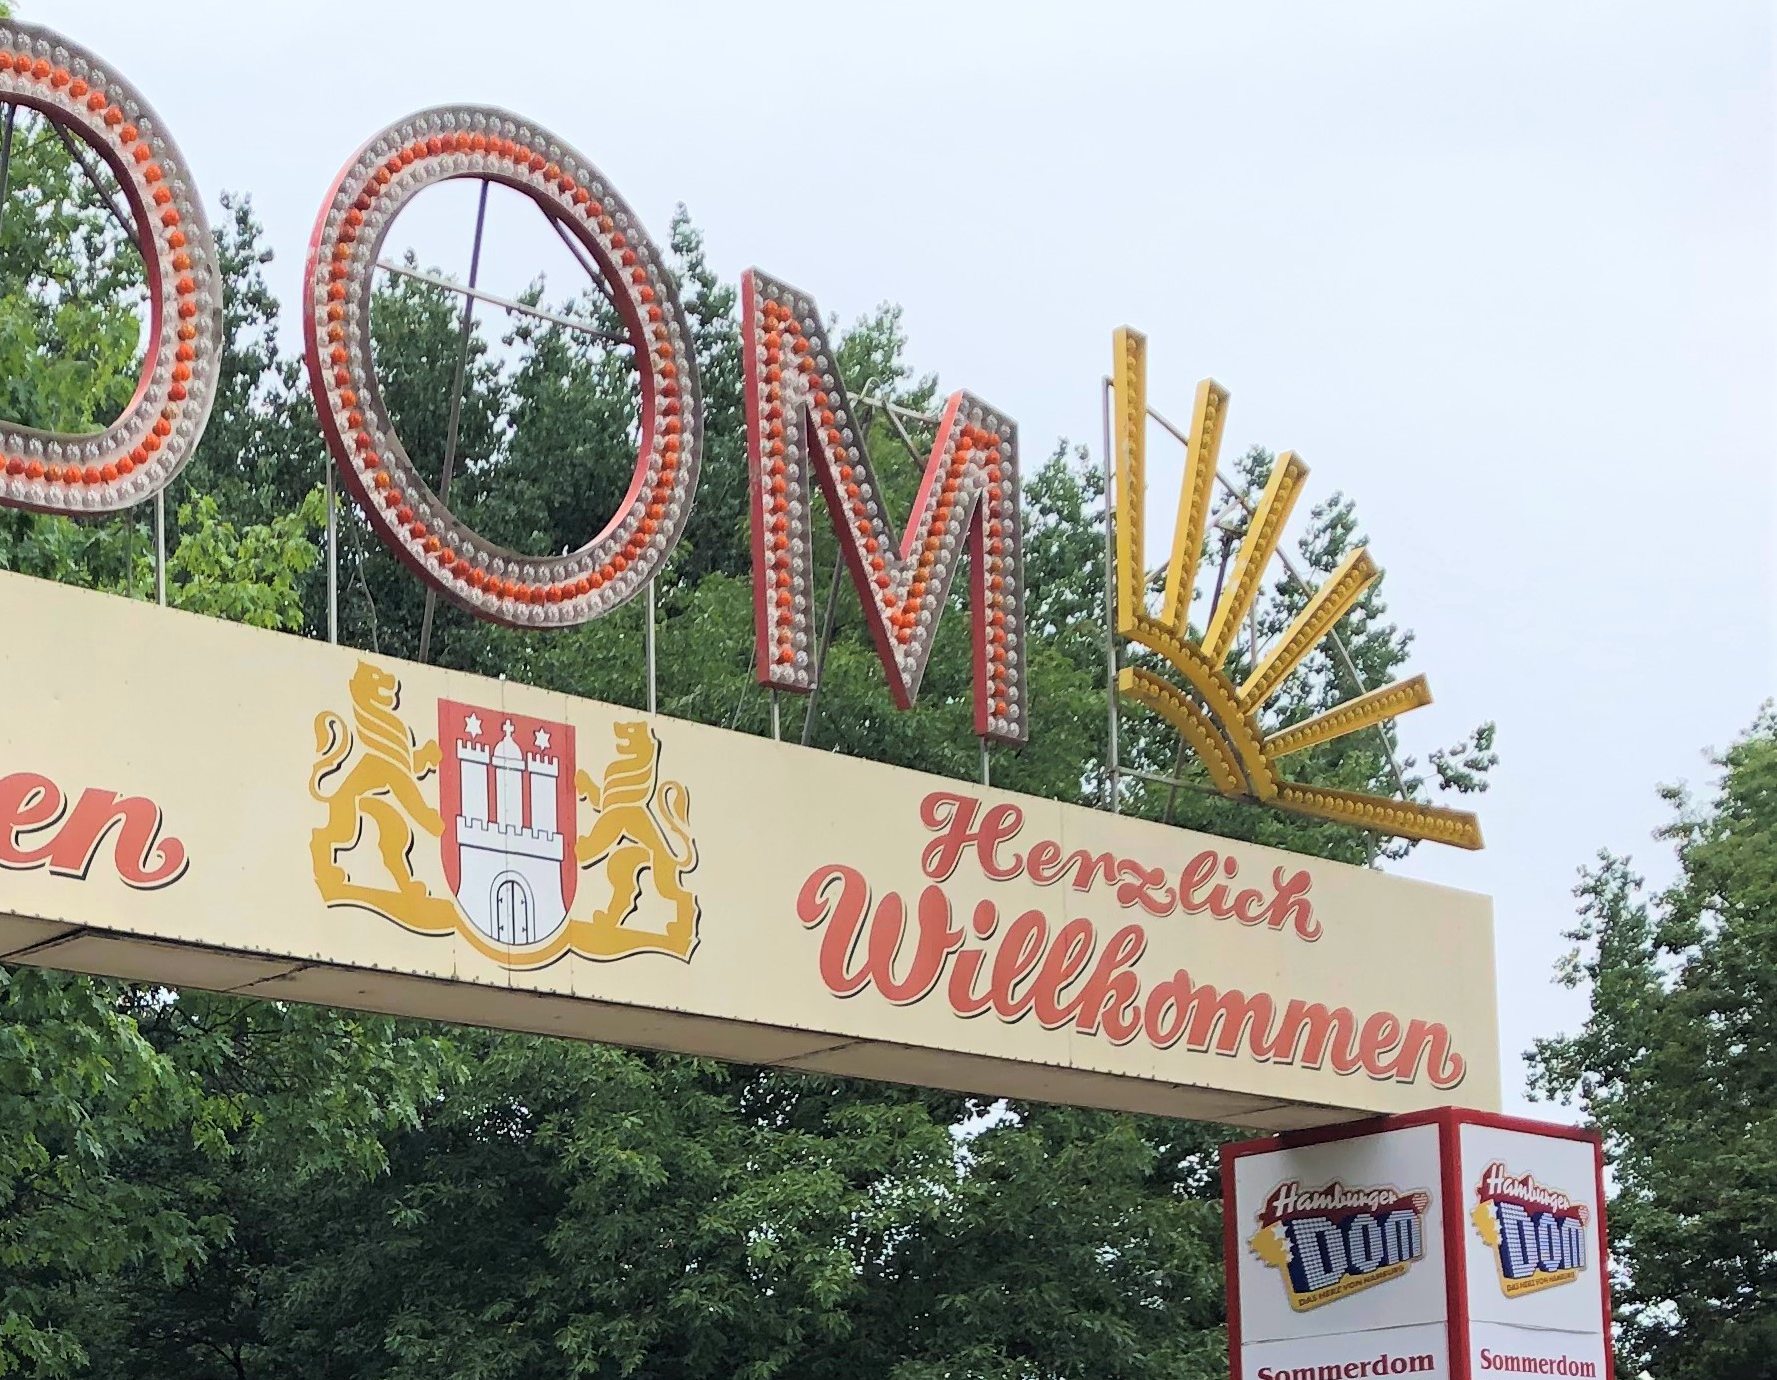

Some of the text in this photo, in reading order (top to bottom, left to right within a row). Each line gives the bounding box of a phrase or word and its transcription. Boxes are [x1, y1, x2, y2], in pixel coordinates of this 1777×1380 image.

[919, 792, 1324, 941] Herzlich
[797, 864, 1466, 1089] Willkommen
[1273, 1183, 1398, 1217] Hamburger
[1487, 1165, 1570, 1213] Hamburger
[1480, 1348, 1596, 1378] Sommerdom
